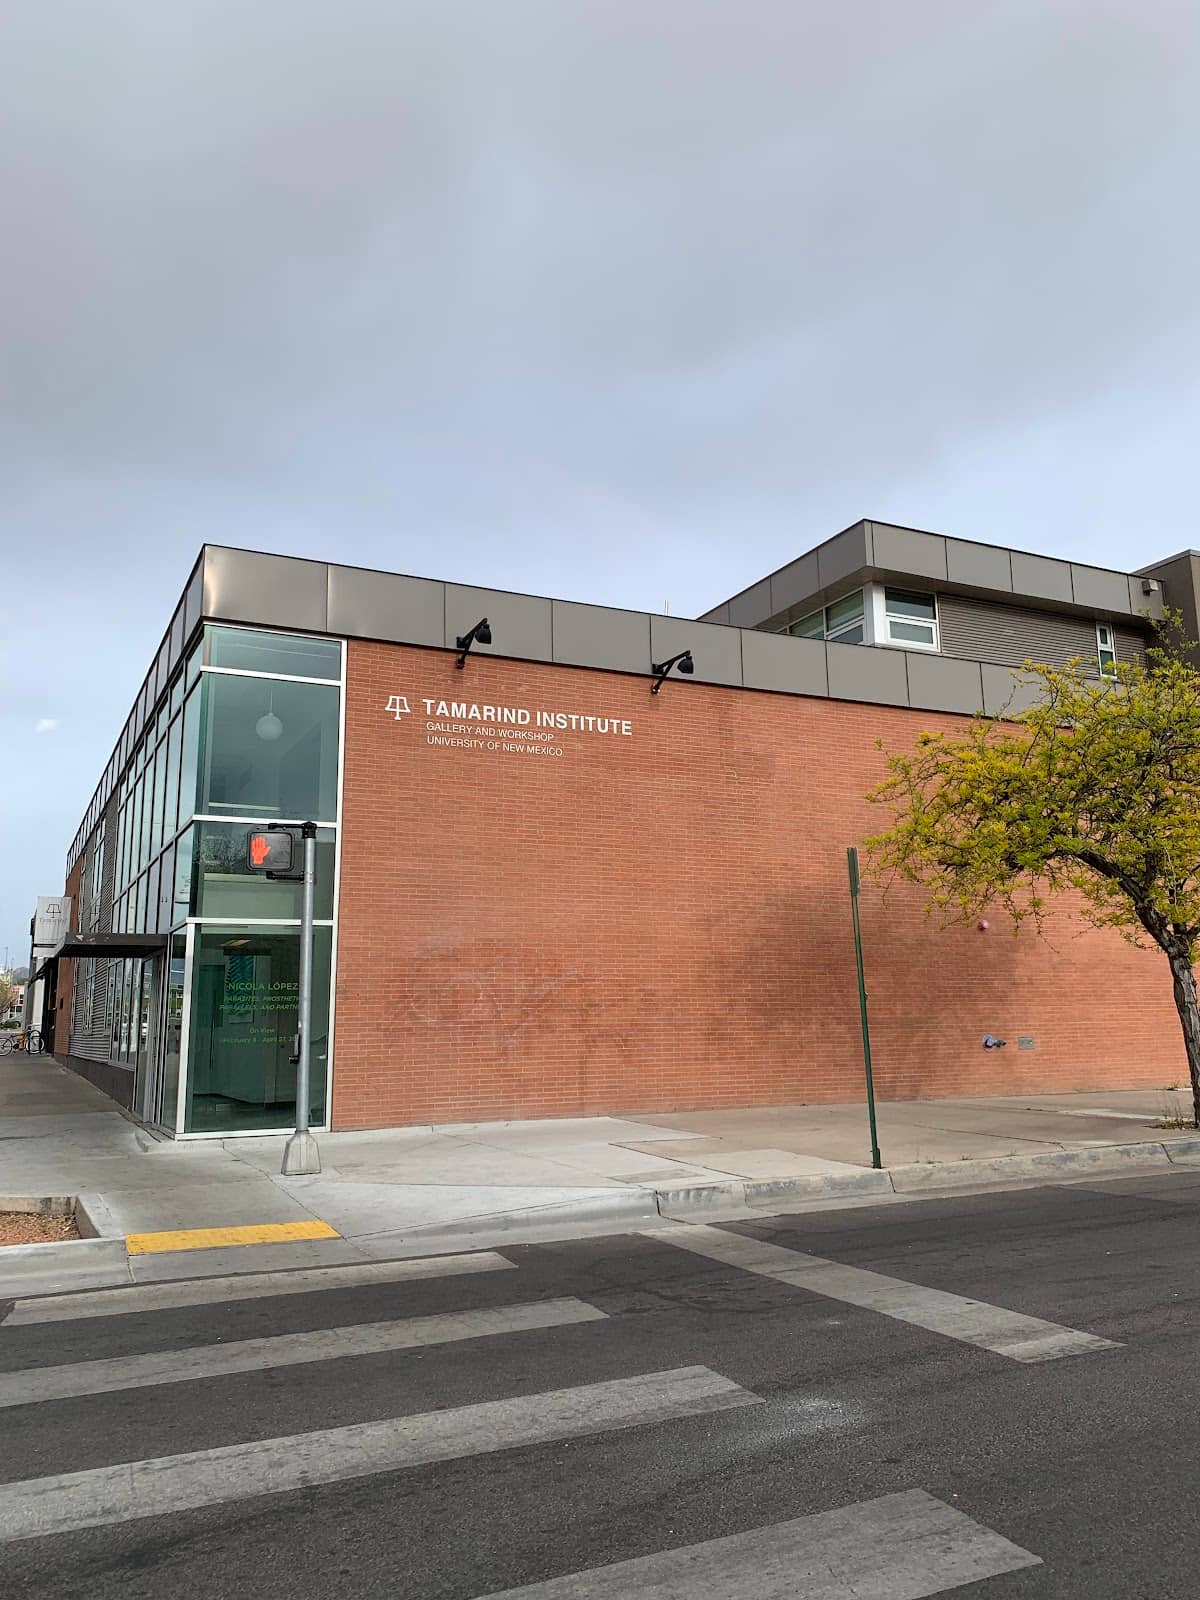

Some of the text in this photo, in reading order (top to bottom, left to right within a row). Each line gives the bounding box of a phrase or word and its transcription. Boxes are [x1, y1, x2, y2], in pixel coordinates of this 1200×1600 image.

[422, 698, 632, 736] TAMARIND INSTITUTE
[426, 721, 554, 742] GALLERY AND WORKSHOP
[427, 735, 563, 757] UNIVERSITY OF NEW MEXICO
[228, 982, 265, 991] NICOLA
